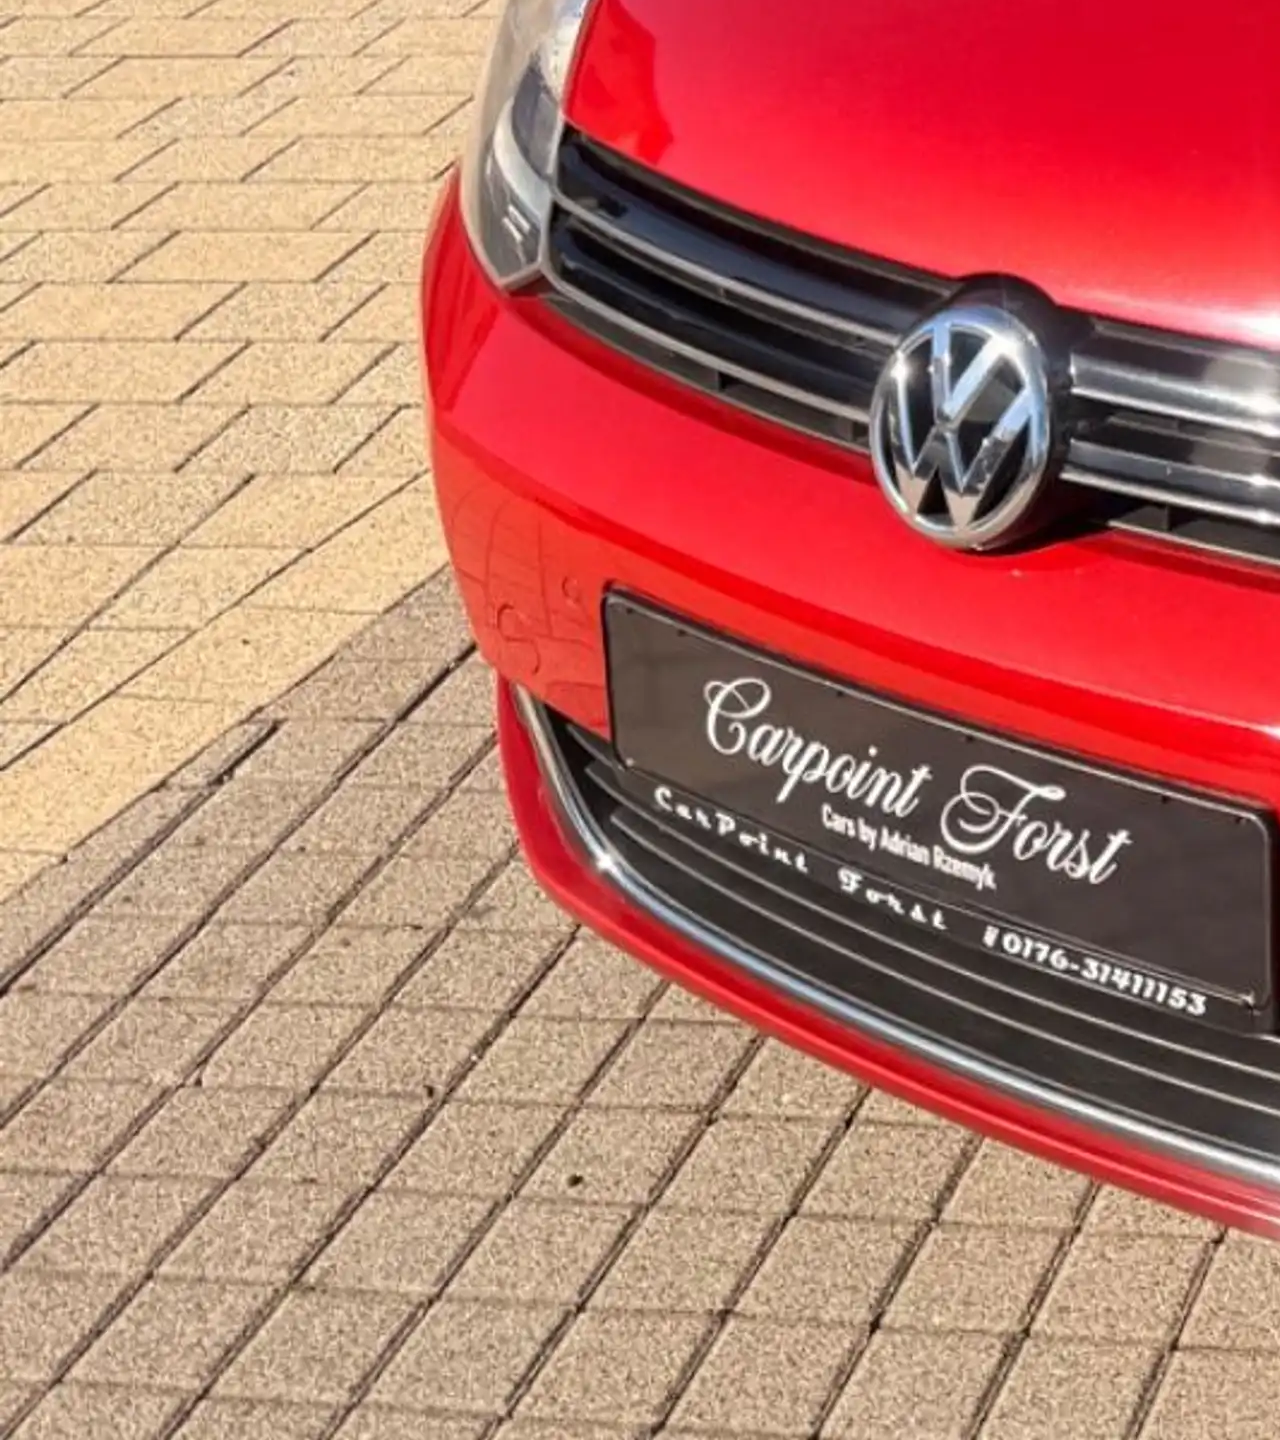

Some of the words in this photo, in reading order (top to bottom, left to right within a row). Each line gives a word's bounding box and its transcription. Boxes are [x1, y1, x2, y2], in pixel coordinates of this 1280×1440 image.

[703, 676, 933, 818] Carpoint
[940, 764, 1132, 885] Forst
[821, 803, 856, 839] Cars
[857, 816, 878, 852] by
[880, 825, 930, 867] Adrian
[837, 866, 947, 931] Forst
[1002, 931, 1208, 1017] 0176-31411153
